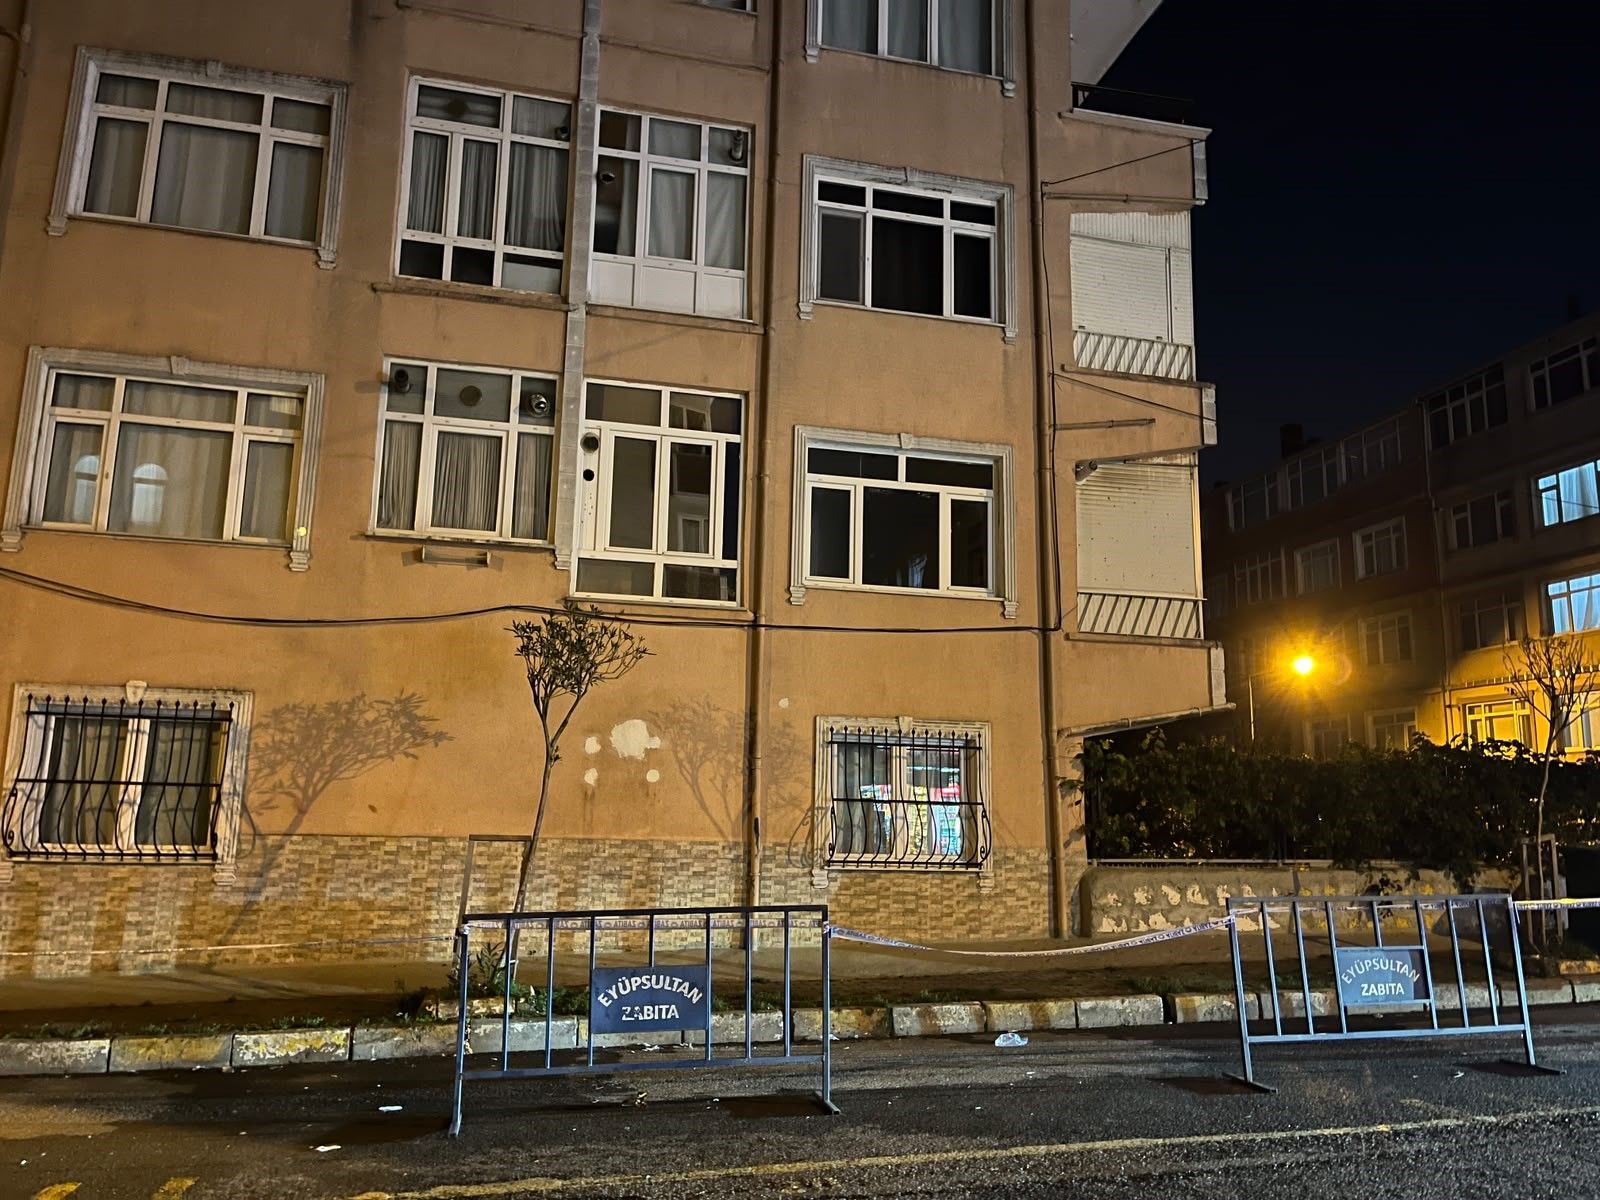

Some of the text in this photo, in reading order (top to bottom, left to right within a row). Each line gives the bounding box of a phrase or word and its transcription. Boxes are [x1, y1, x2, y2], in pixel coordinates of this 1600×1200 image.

[1341, 956, 1420, 984] EYÜPSULTAN
[597, 974, 703, 1007] EYÜPSULTAN
[1361, 982, 1405, 996] ZABITA
[621, 1004, 680, 1021] ZABITA
